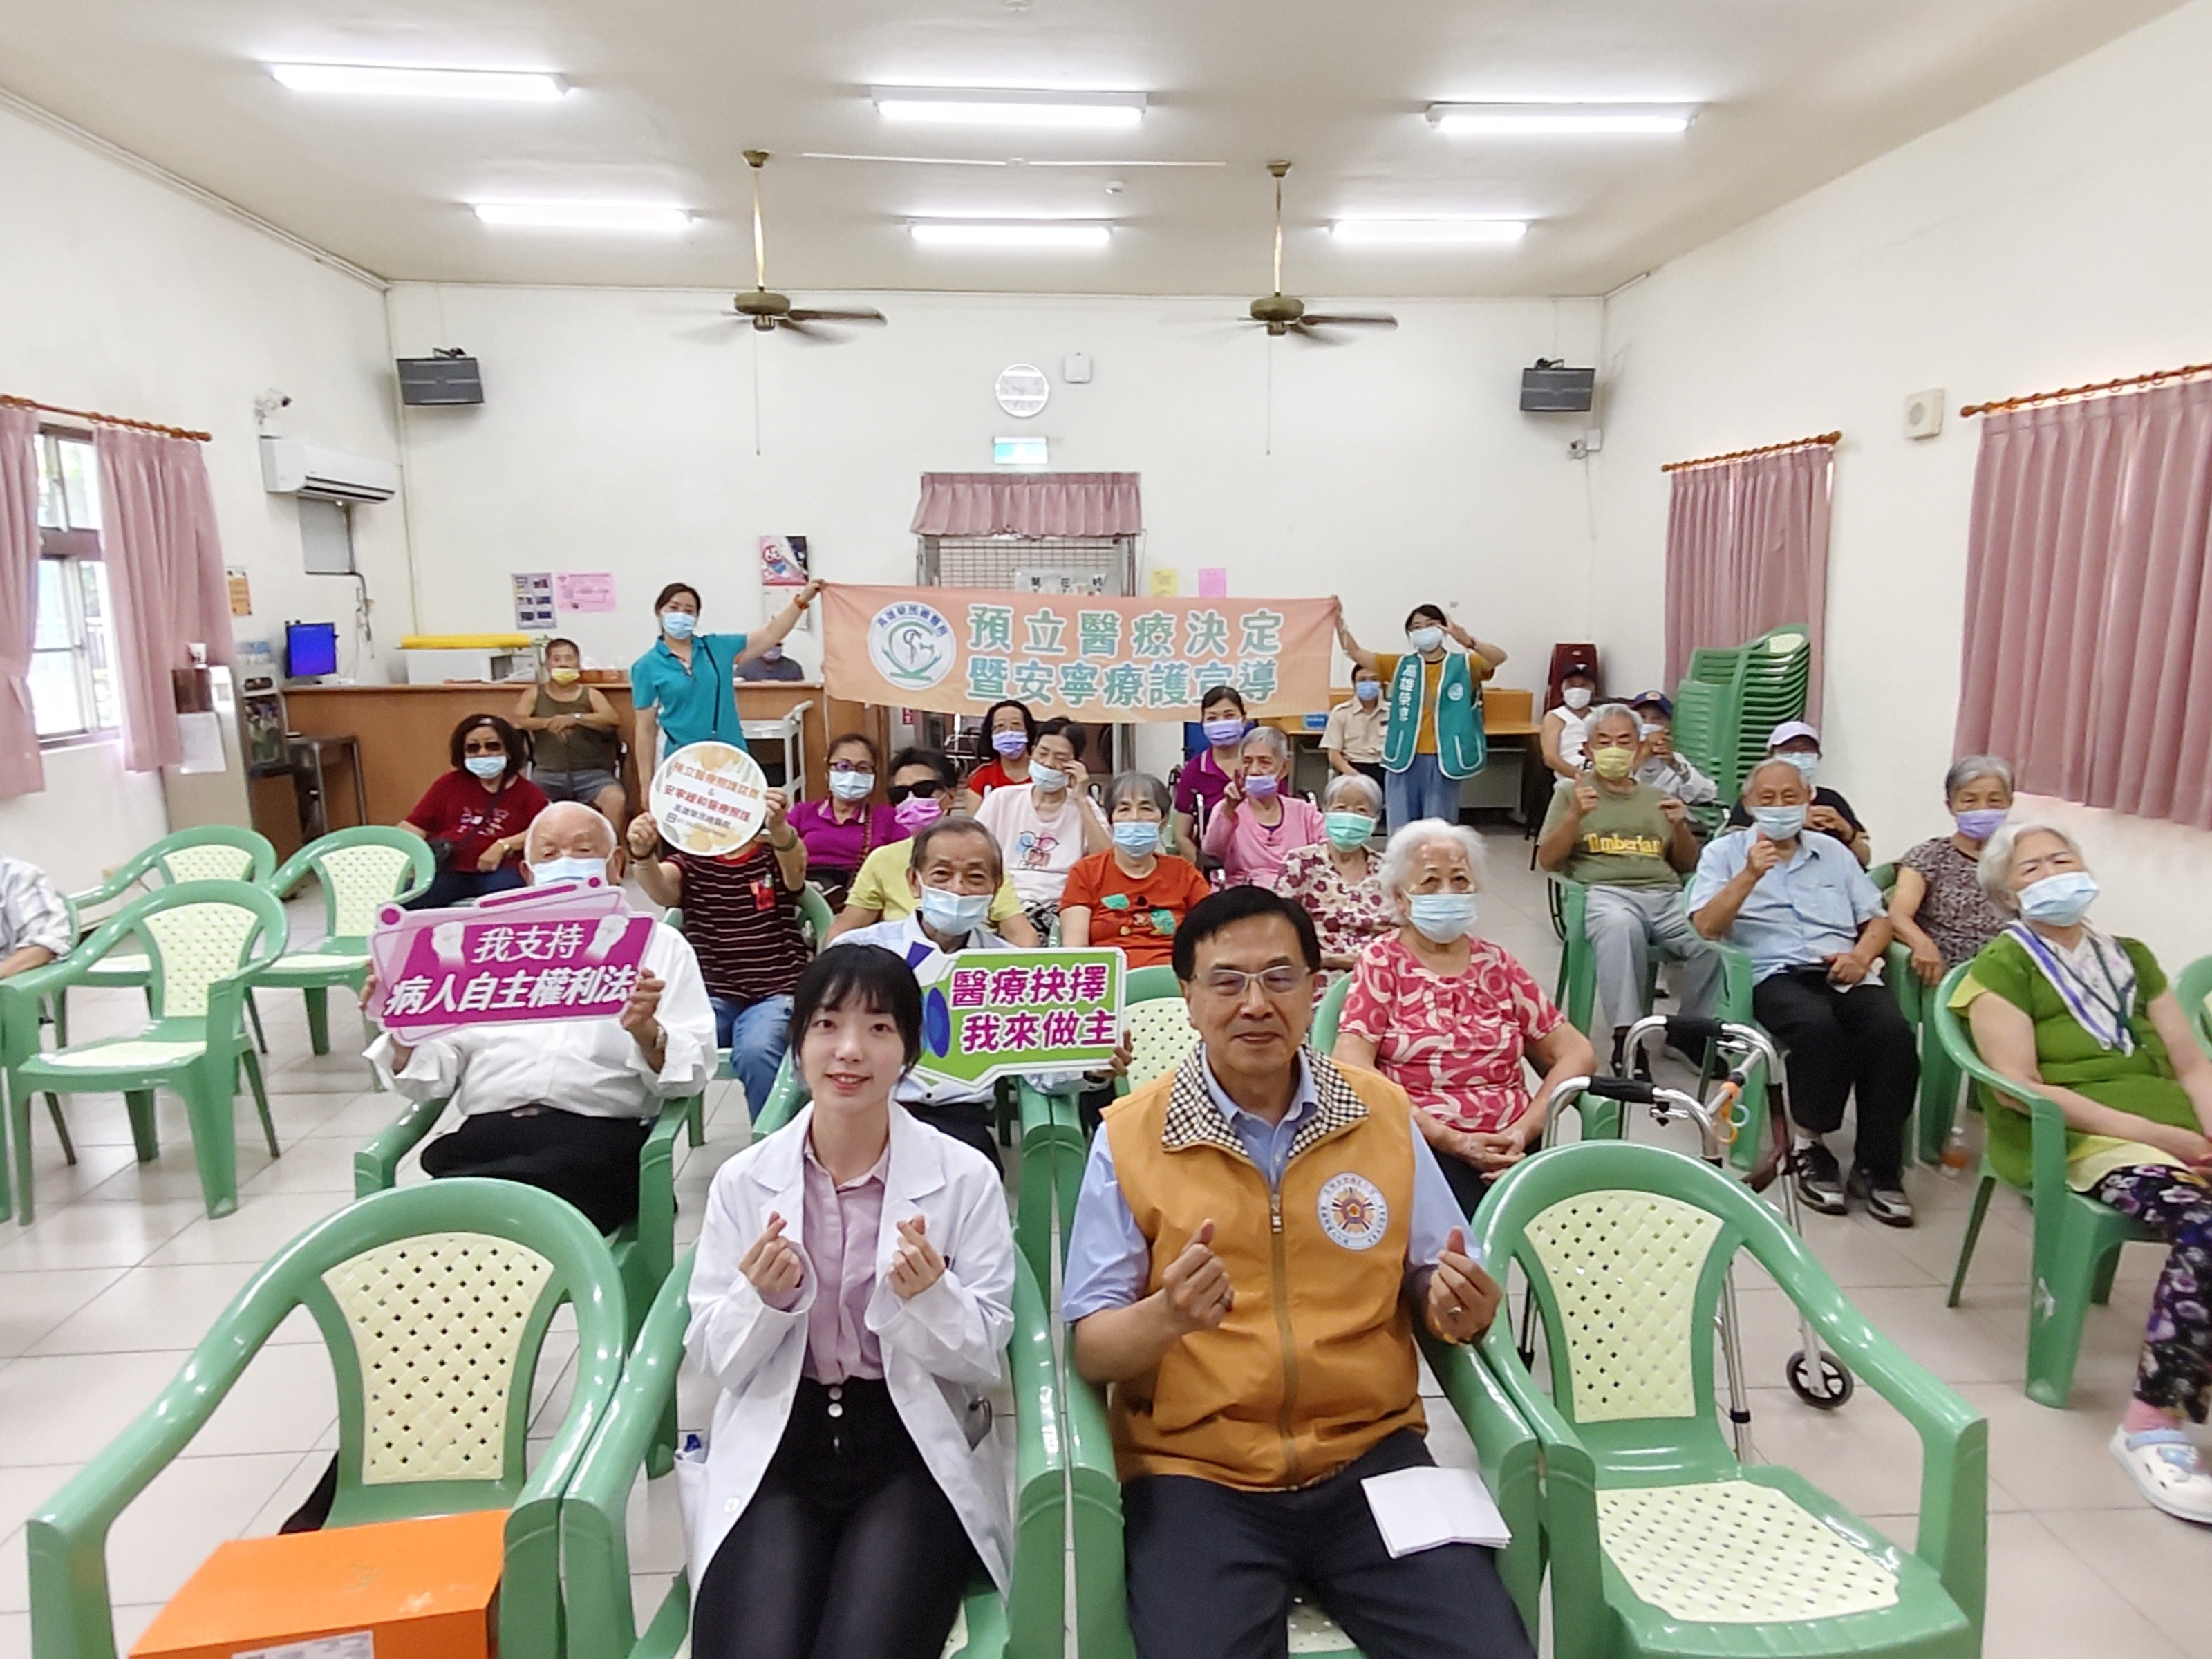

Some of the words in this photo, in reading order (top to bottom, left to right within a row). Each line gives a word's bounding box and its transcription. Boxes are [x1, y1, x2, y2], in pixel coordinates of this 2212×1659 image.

[968, 604, 1282, 655] 預立醫療決定
[968, 657, 1276, 705] 暨安寧療護宣導
[1584, 833, 1662, 855] Timberlan
[471, 924, 585, 964] 我支持
[382, 964, 638, 1016] 病人自主權利法
[951, 965, 1107, 1007] 醫療抉擇
[963, 1010, 1116, 1051] 我來做主
